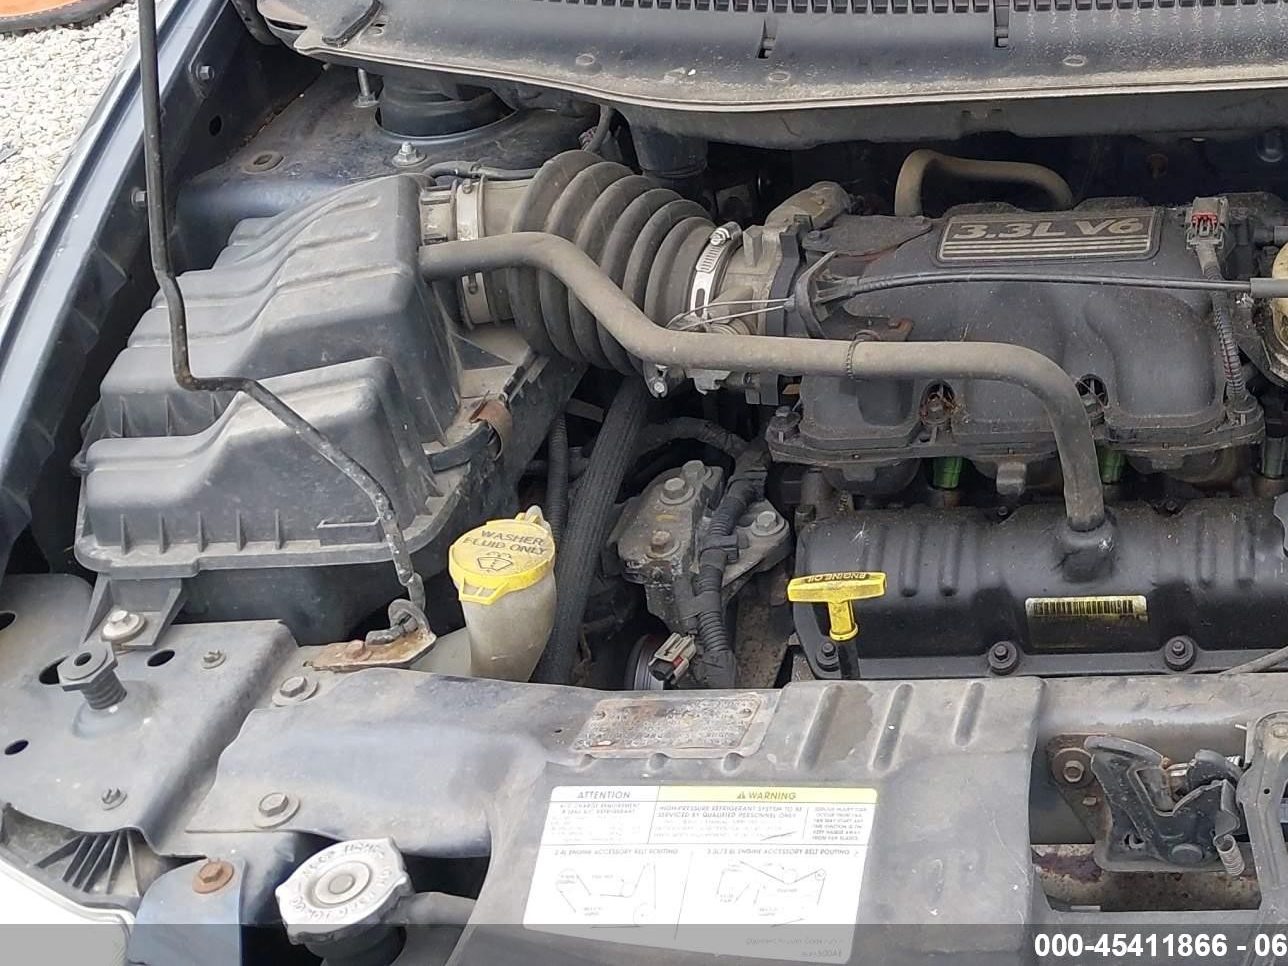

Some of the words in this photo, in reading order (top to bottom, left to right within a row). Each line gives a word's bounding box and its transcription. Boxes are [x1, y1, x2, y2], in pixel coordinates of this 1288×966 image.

[952, 222, 1066, 239] 3.3L
[1074, 217, 1144, 235] V6
[462, 536, 506, 549] FLUID
[509, 544, 548, 555] ONLY
[482, 530, 545, 546] WASHER
[576, 791, 631, 800] ATTENTION
[748, 792, 797, 801] WARNING
